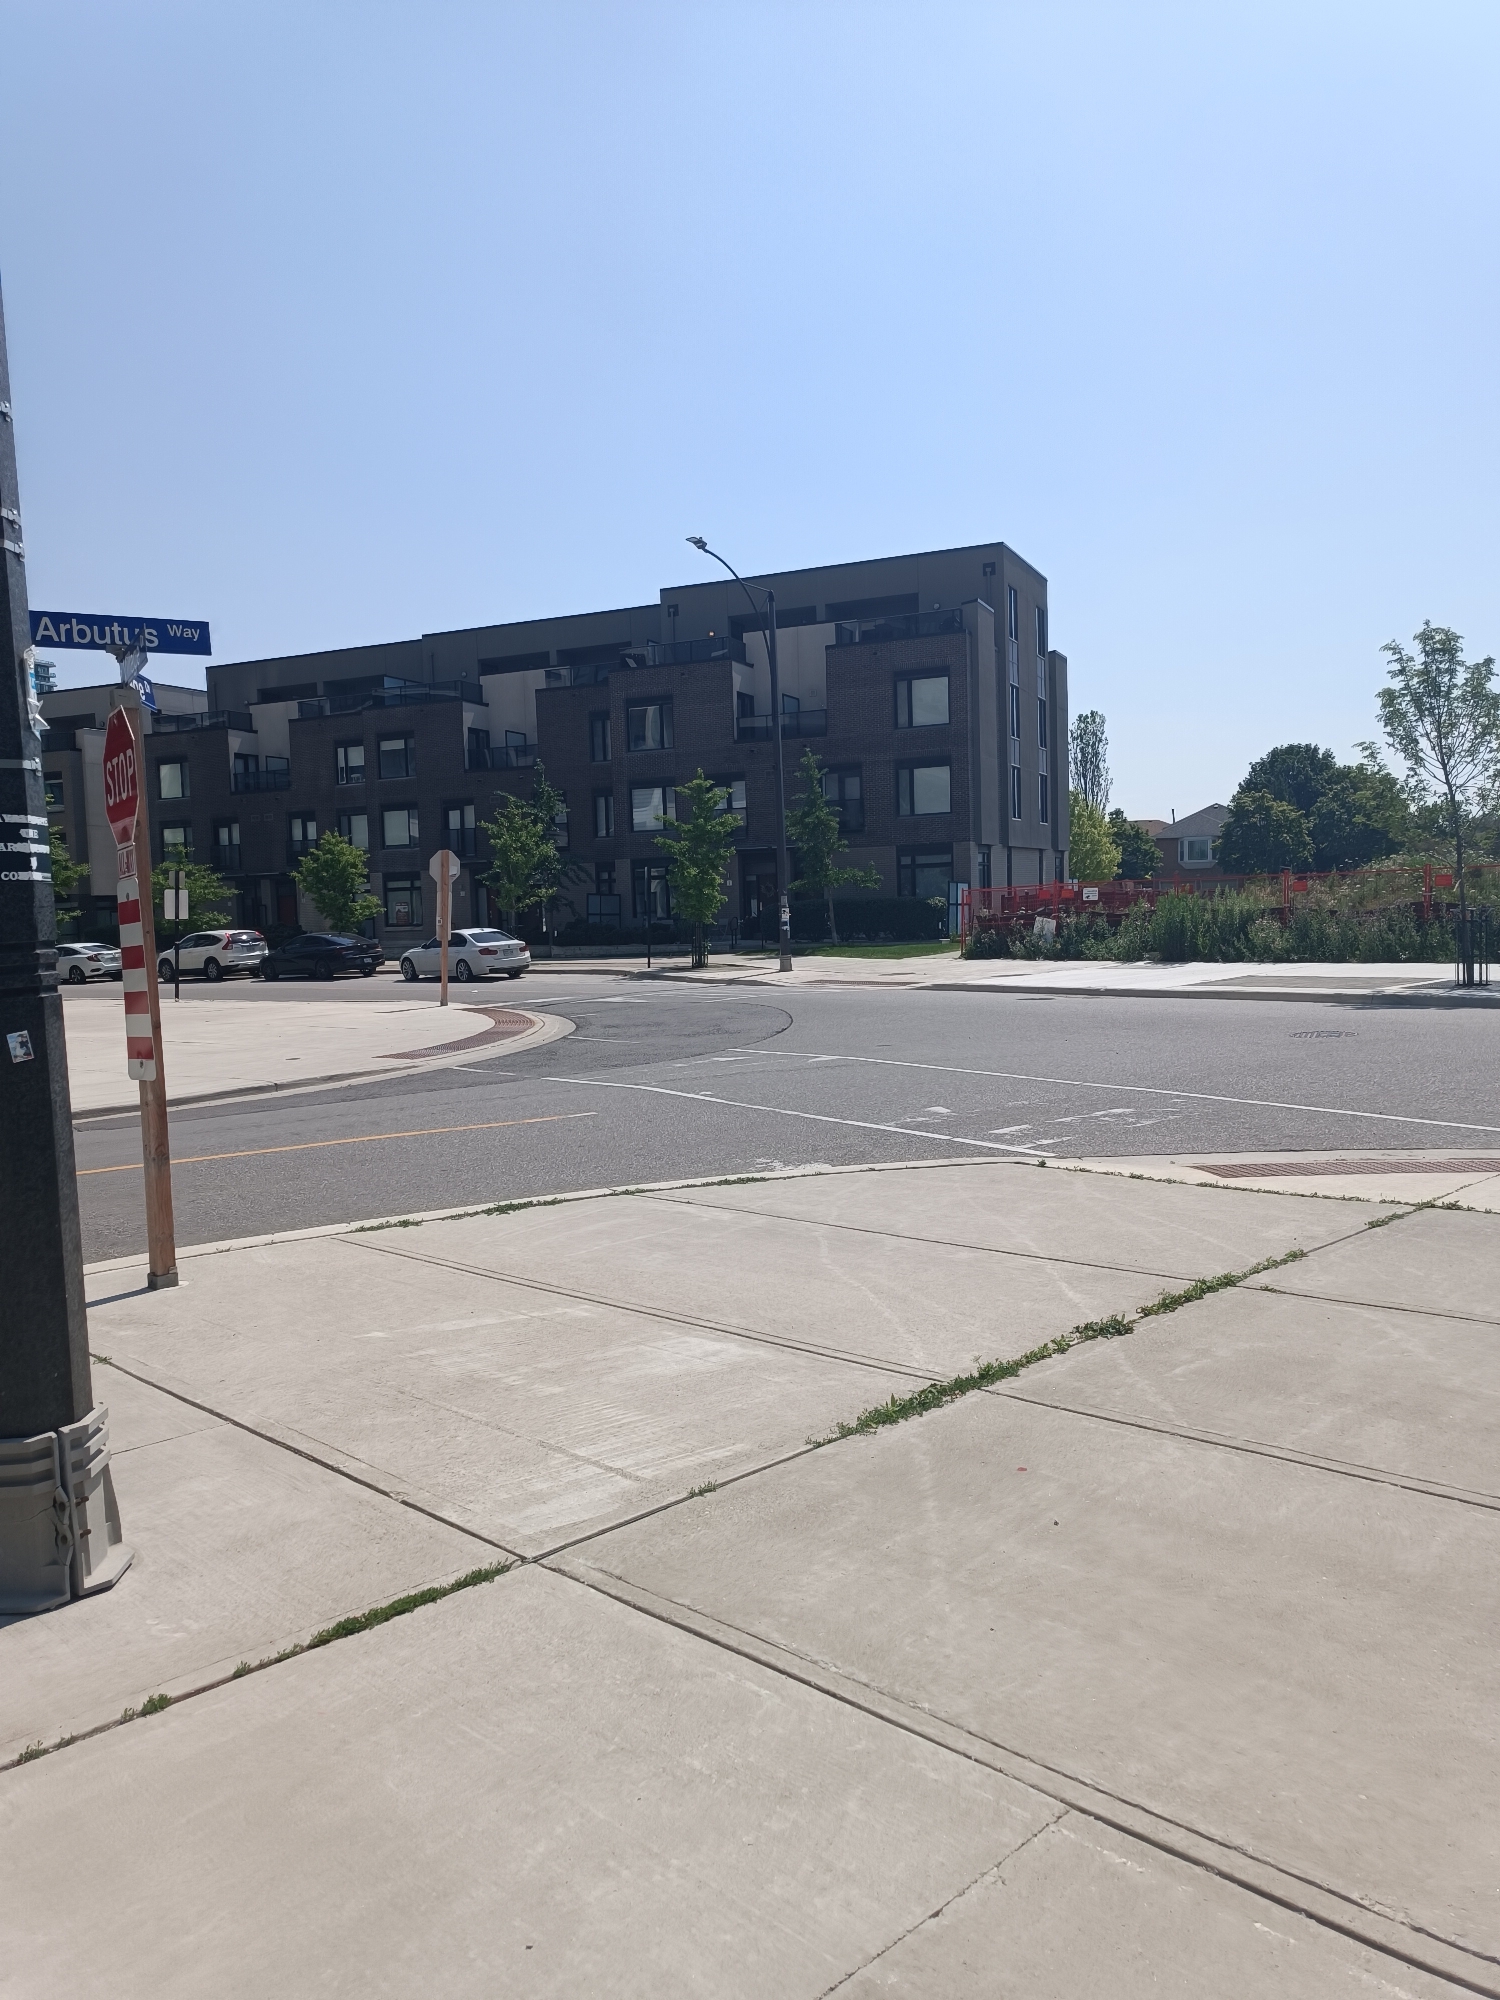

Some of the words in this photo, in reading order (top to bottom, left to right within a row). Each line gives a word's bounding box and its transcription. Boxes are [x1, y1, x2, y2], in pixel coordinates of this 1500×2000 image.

[35, 616, 159, 648] Arbutus
[166, 624, 200, 642] Way
[106, 748, 134, 806] STOP
